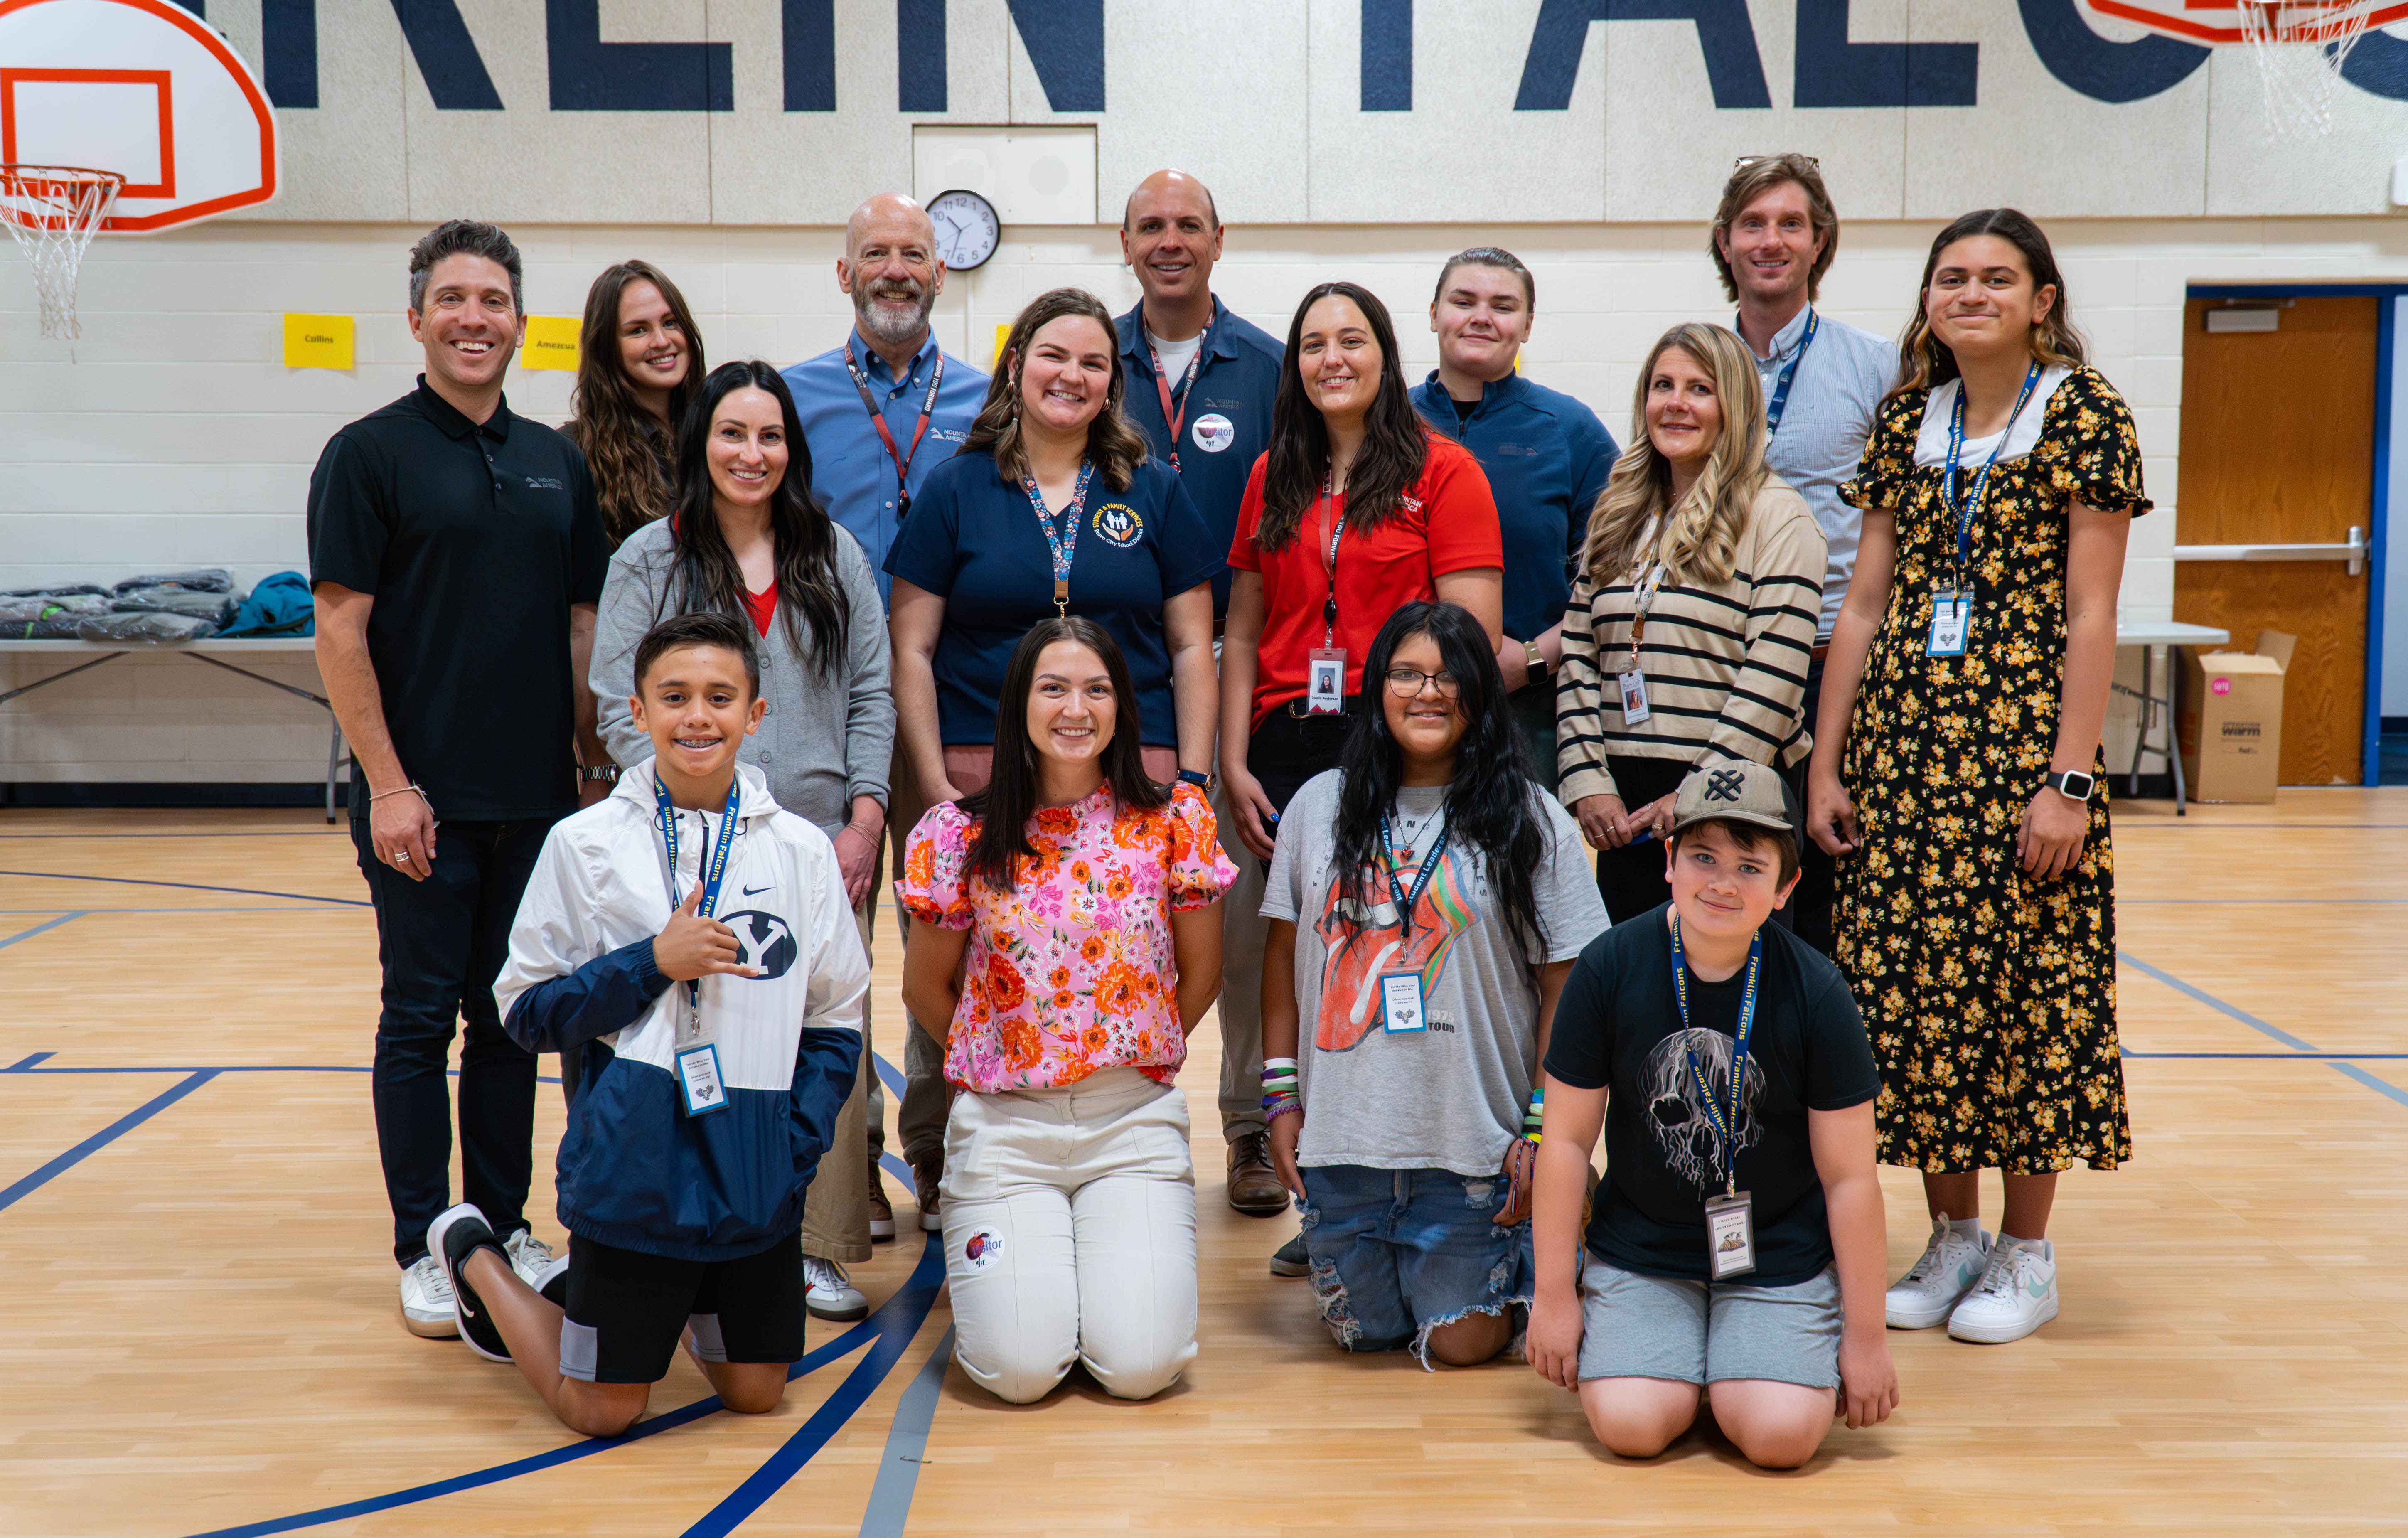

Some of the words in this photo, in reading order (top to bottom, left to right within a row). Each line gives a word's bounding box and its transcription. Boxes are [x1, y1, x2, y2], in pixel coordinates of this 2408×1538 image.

[944, 200, 952, 210] 11
[956, 197, 967, 207] 12
[972, 201, 976, 210] 1
[933, 210, 945, 221] 10
[981, 211, 989, 221] 2
[986, 226, 994, 236] 3
[944, 249, 951, 260] 7
[982, 240, 988, 249] 4
[957, 253, 964, 263] 6
[972, 250, 979, 260] 5
[305, 334, 334, 344] Collins
[536, 340, 576, 350] Amezcua
[935, 359, 943, 377] GUIDING
[1188, 358, 1198, 379] GUIDING
[924, 387, 937, 412] FORWARD
[1954, 404, 1962, 433] Falcons
[945, 435, 966, 443] AMERIC
[1949, 433, 1960, 464] Franklin
[1973, 463, 1990, 498] Franklin
[1092, 508, 1104, 528] STUDENT
[1125, 507, 1143, 527] SERVICES
[1963, 499, 1978, 534] Falcons
[1094, 528, 1106, 540] Provo
[1106, 538, 1117, 547] City
[1131, 528, 1143, 544] District
[1336, 522, 1344, 533] YOU
[664, 806, 674, 843] Falcons
[723, 806, 736, 844] Franklin
[711, 844, 727, 881] Falcons
[1391, 877, 1402, 901] Team
[703, 895, 714, 918] Fran
[722, 915, 788, 974] Y
[1677, 967, 1686, 1007] Falcons
[1746, 956, 1758, 998] Franklin
[1428, 1022, 1454, 1034] TOUR
[1739, 1000, 1752, 1040] Falcons
[1694, 1066, 1714, 1103] Falcons
[1732, 1055, 1743, 1098] Franklin
[972, 1240, 1002, 1256] Visitor
